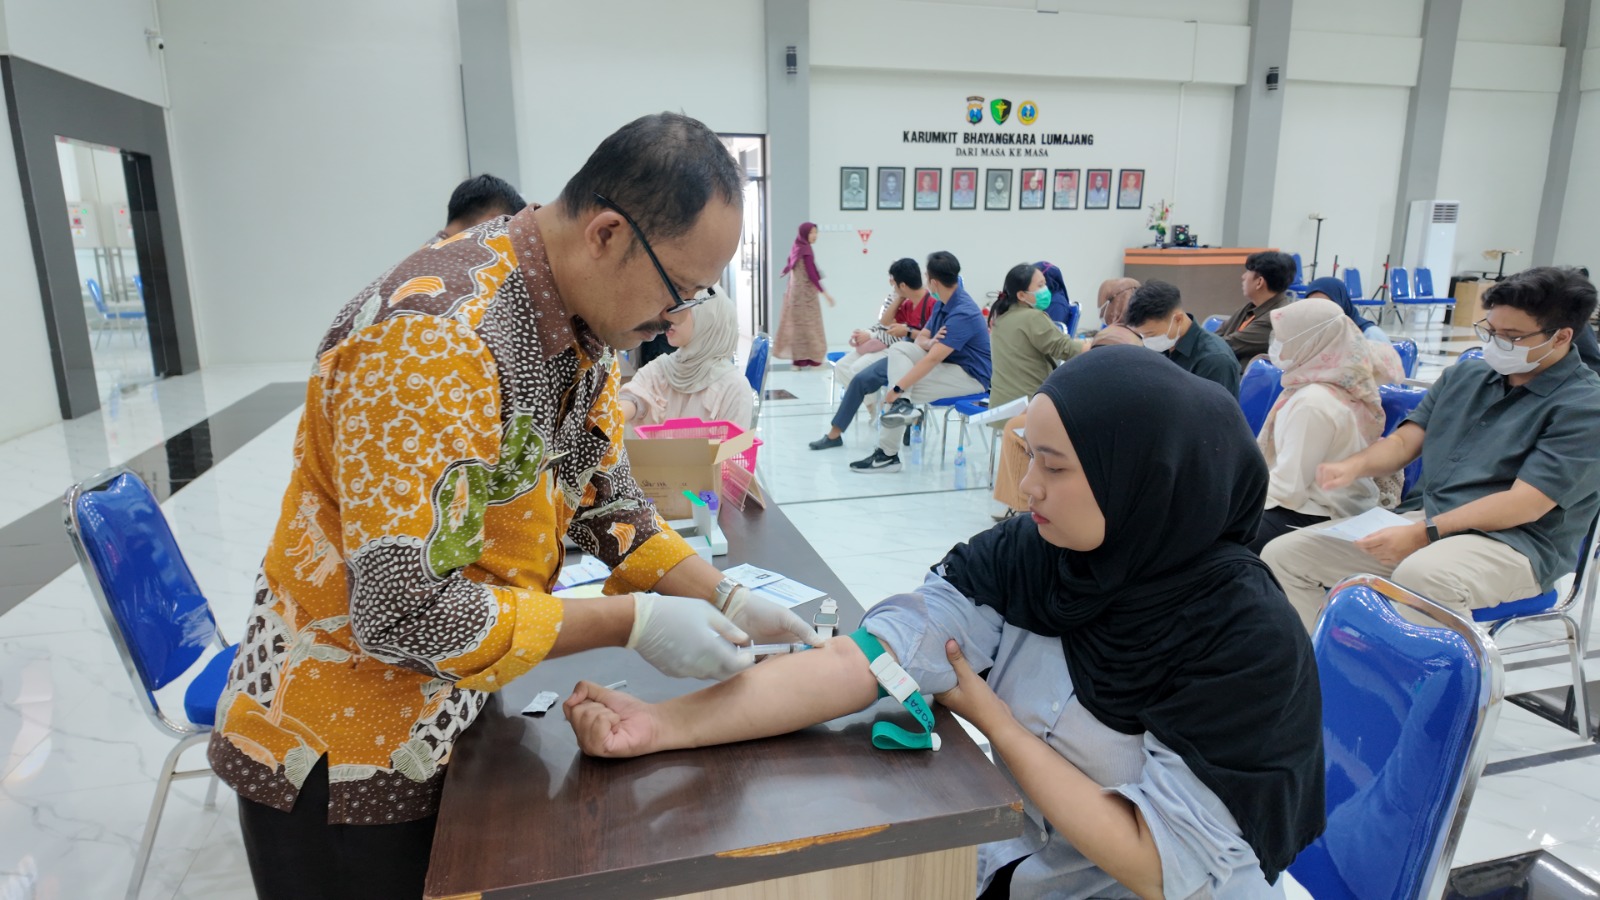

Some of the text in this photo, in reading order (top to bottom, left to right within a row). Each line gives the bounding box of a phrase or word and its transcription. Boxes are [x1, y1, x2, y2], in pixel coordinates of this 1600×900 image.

[903, 131, 1094, 146] KARUMKIT BHAYANGKARA LUMAJANG
[955, 147, 1049, 157] DARI MASA KE MASA
